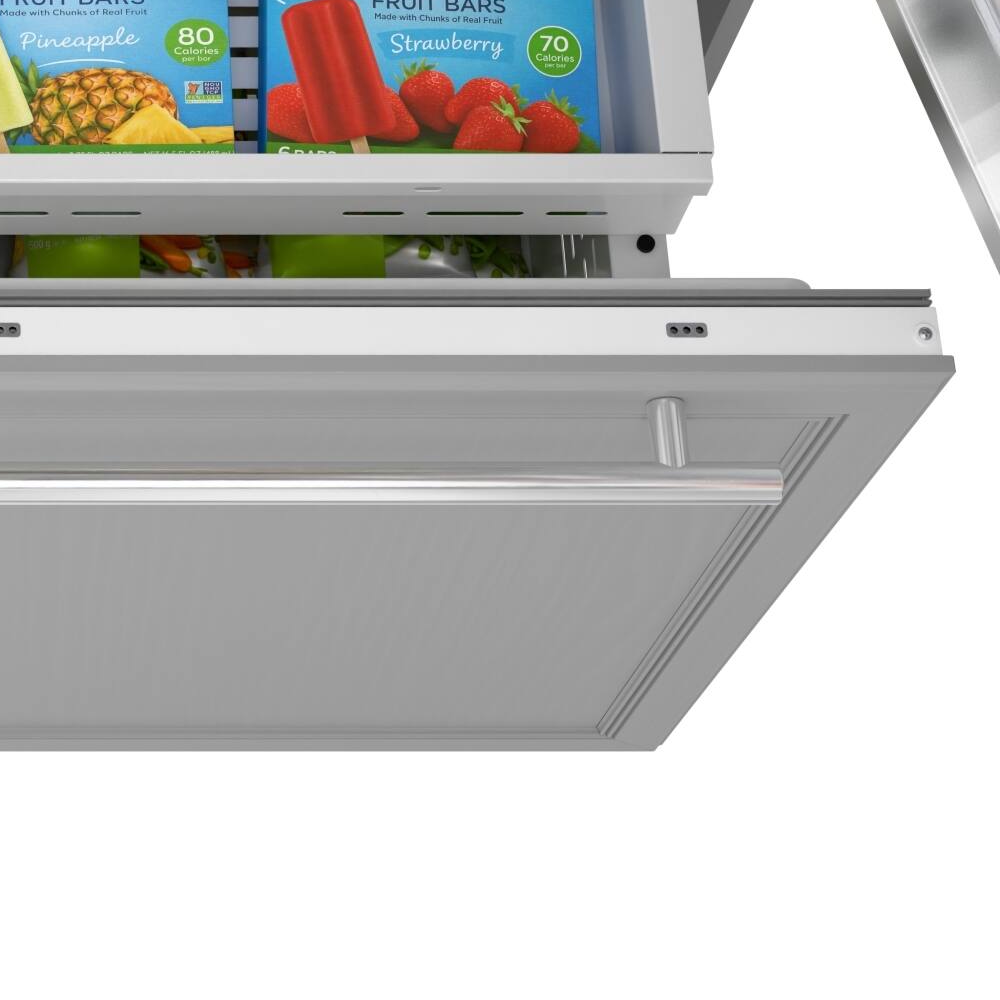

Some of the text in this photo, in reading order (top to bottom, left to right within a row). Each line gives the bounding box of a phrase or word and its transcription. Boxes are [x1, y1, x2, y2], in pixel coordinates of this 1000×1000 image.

[0, 9, 28, 17] Made
[52, 8, 87, 17] Chunks
[90, 8, 100, 16] of
[102, 8, 123, 16] Real
[125, 8, 148, 16] Fruit
[374, 13, 503, 25] Made with Chunks of Real Fruit
[19, 26, 140, 52] Pineapple
[178, 27, 214, 46] 80
[389, 32, 504, 60] Strawberry
[540, 35, 569, 52] 70
[173, 47, 219, 56] Calories
[182, 55, 211, 64] per bar
[535, 53, 575, 63] Calories
